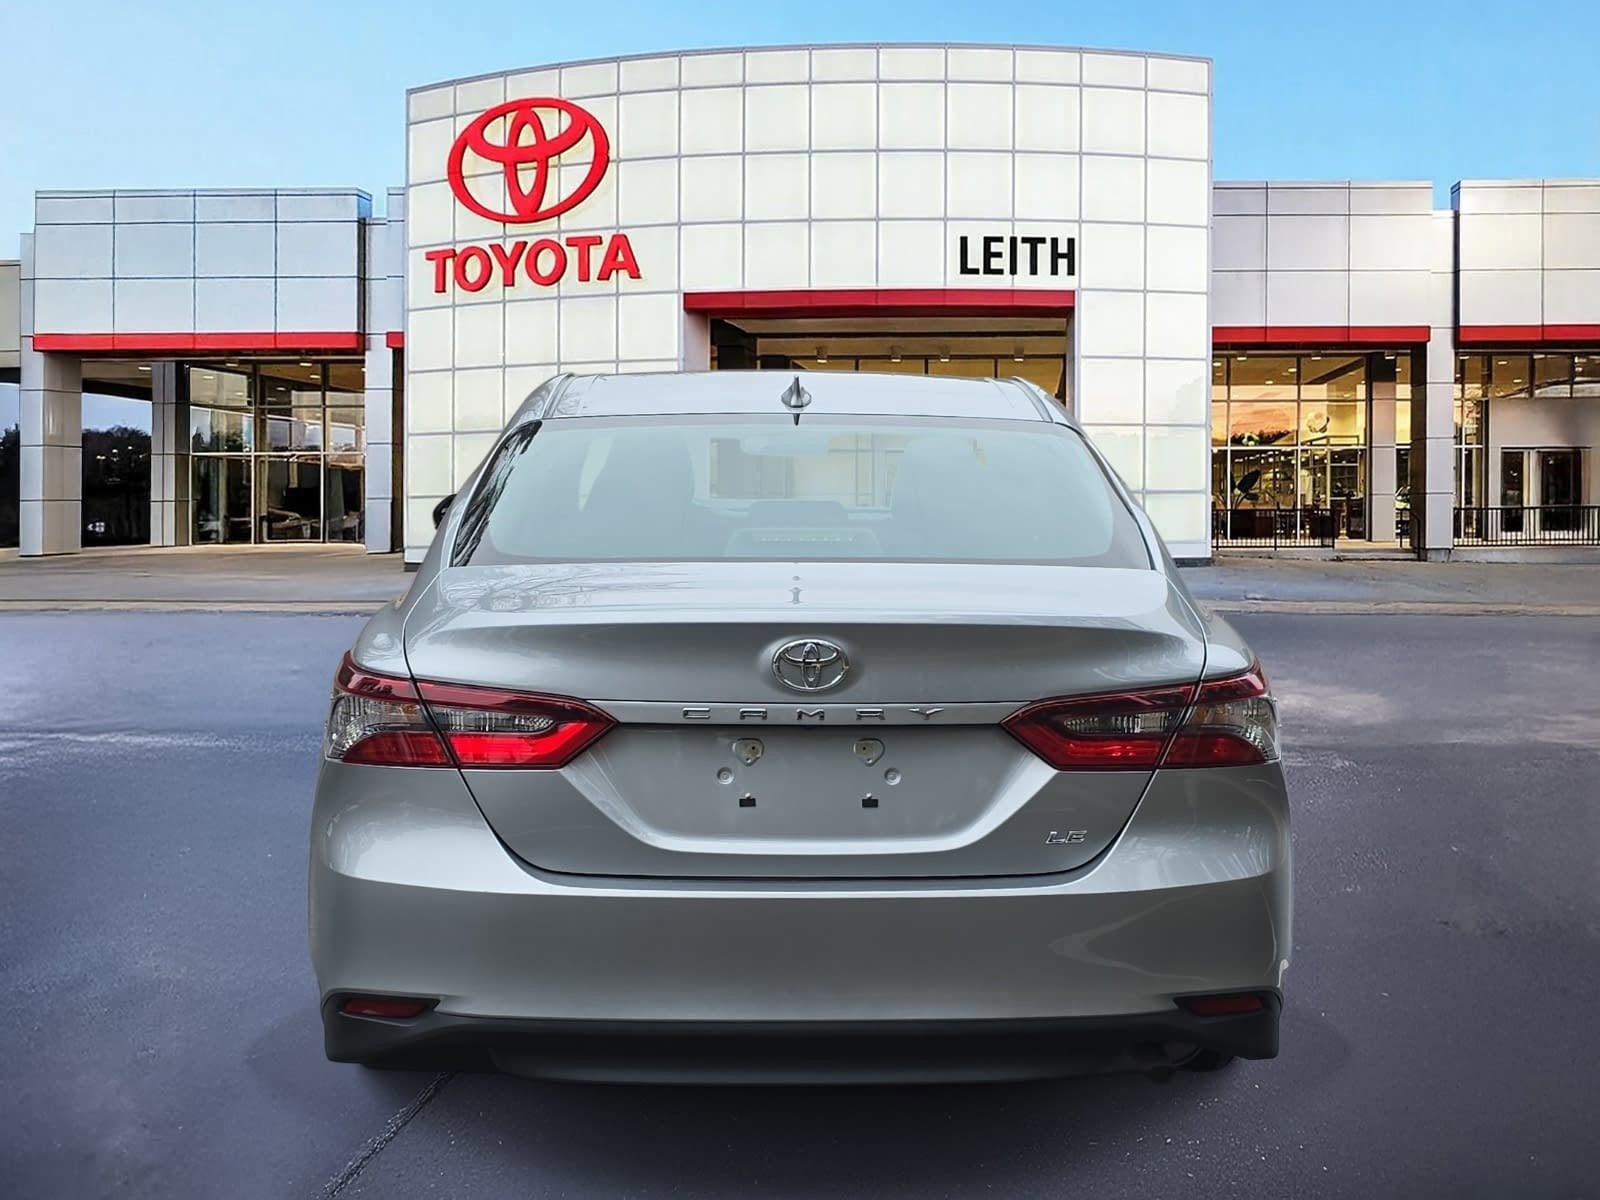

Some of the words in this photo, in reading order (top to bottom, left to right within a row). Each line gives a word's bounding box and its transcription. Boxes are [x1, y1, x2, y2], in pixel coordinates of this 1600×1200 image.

[425, 233, 642, 293] TOYOTA
[959, 235, 1076, 276] LEITH
[682, 707, 944, 721] CAMRY
[1046, 830, 1088, 844] LE
